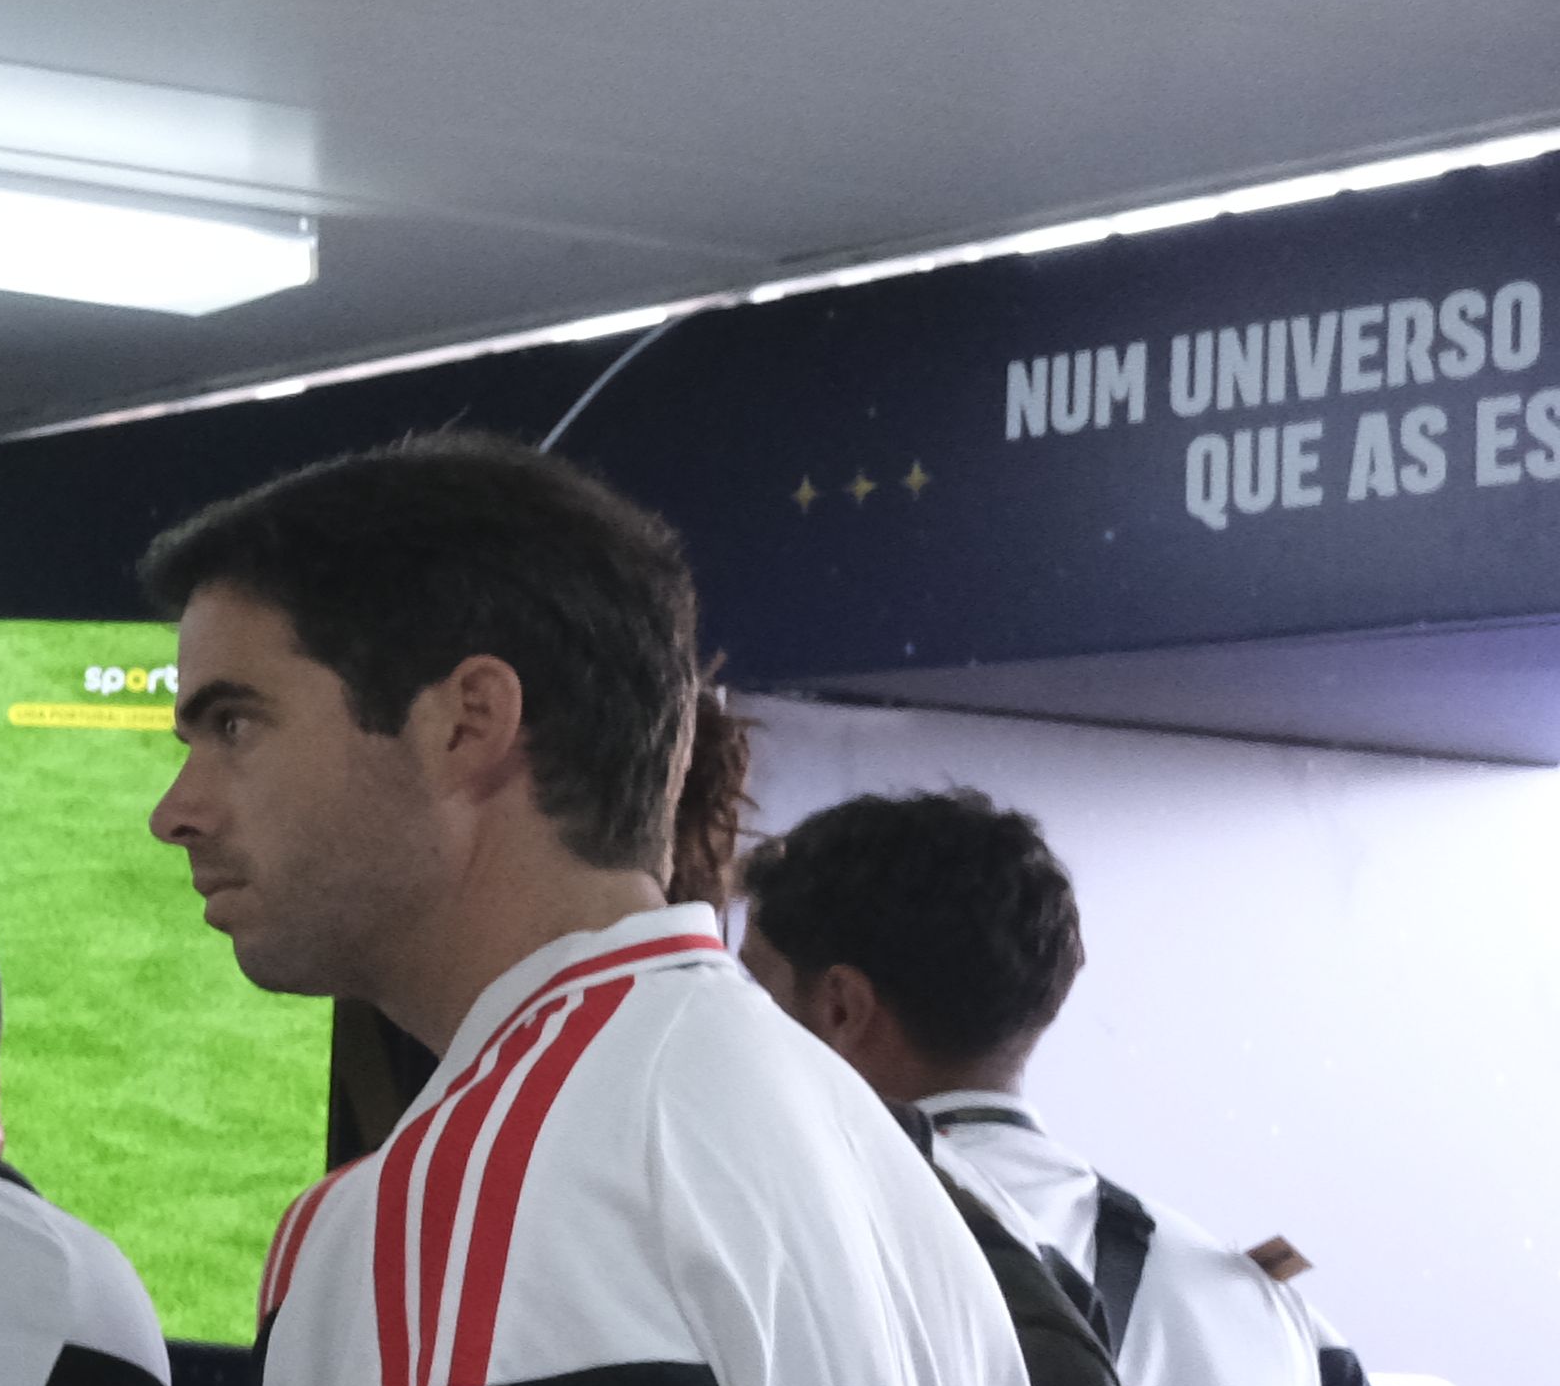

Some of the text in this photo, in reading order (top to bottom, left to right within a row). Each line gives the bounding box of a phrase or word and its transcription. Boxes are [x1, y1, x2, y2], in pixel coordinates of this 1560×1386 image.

[1005, 280, 1542, 441] NUM UNIVERSO
[1186, 387, 1560, 531] QUE AS ES
[84, 665, 179, 696] sport
